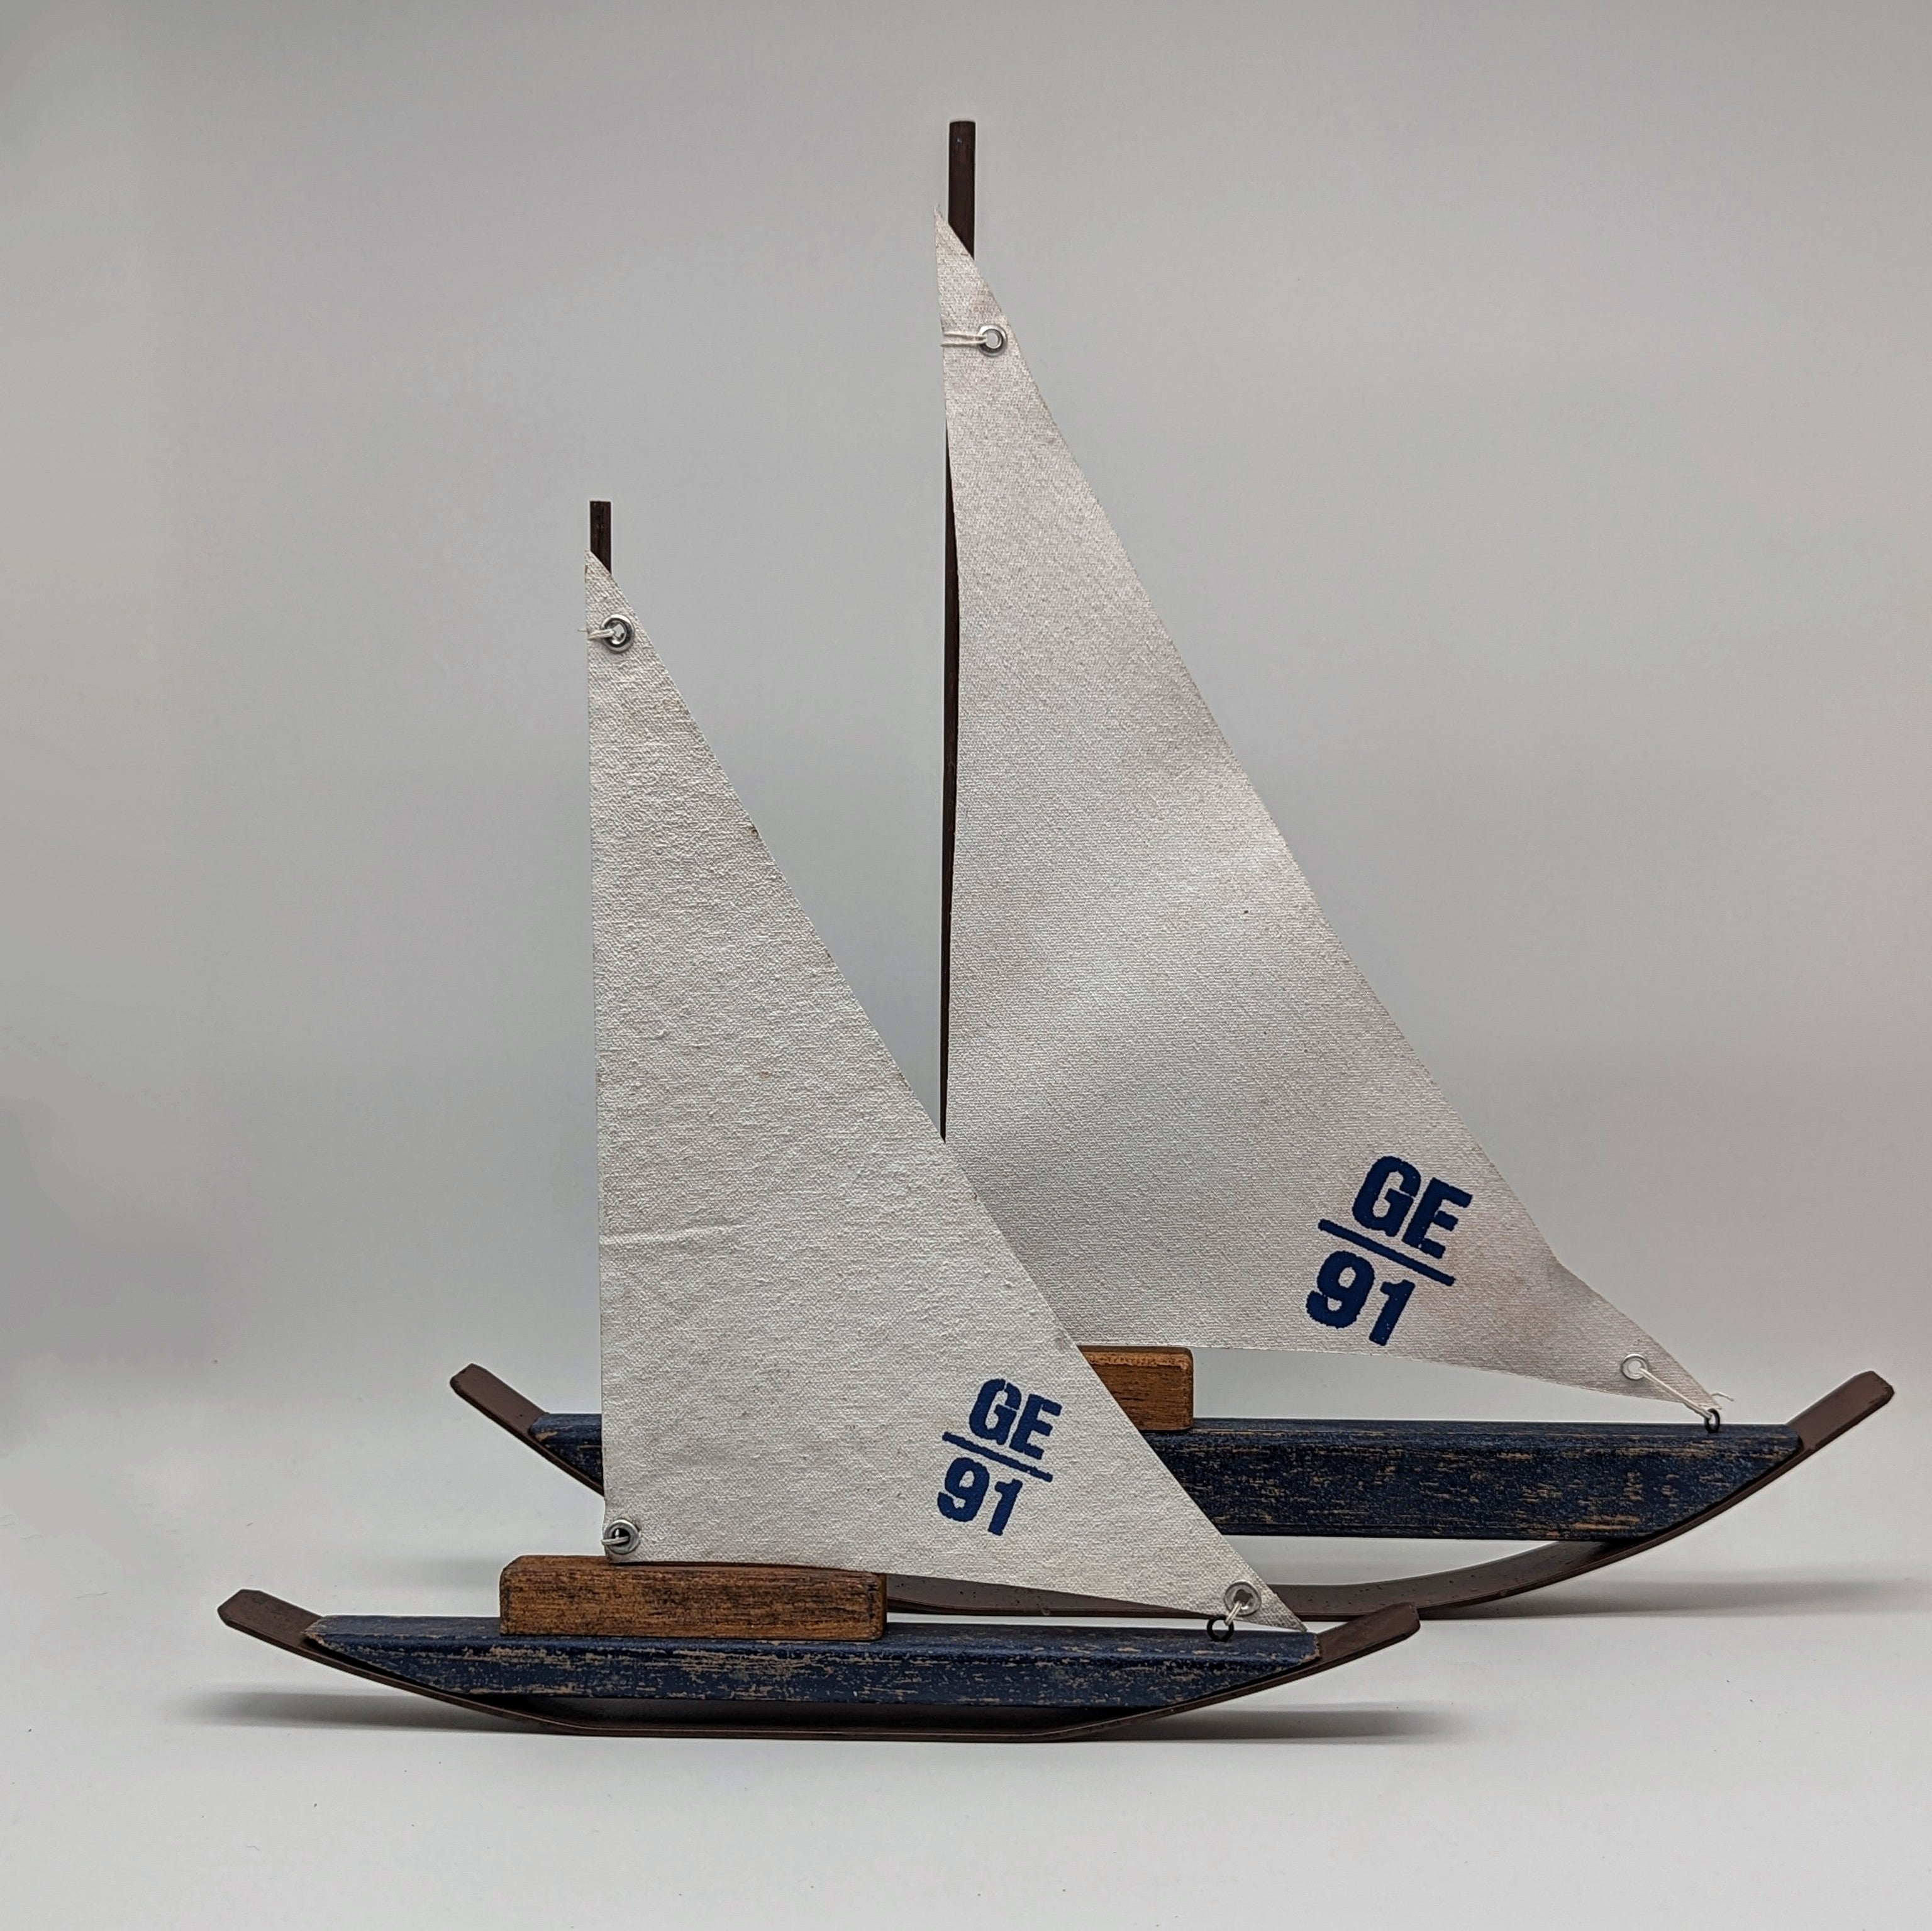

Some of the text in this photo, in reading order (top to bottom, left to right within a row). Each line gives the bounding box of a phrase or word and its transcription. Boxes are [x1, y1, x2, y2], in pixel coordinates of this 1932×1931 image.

[1352, 1156, 1473, 1259] GE
[1306, 1250, 1415, 1346] 91
[969, 1378, 1063, 1460] GE
[937, 1457, 1023, 1536] 91
